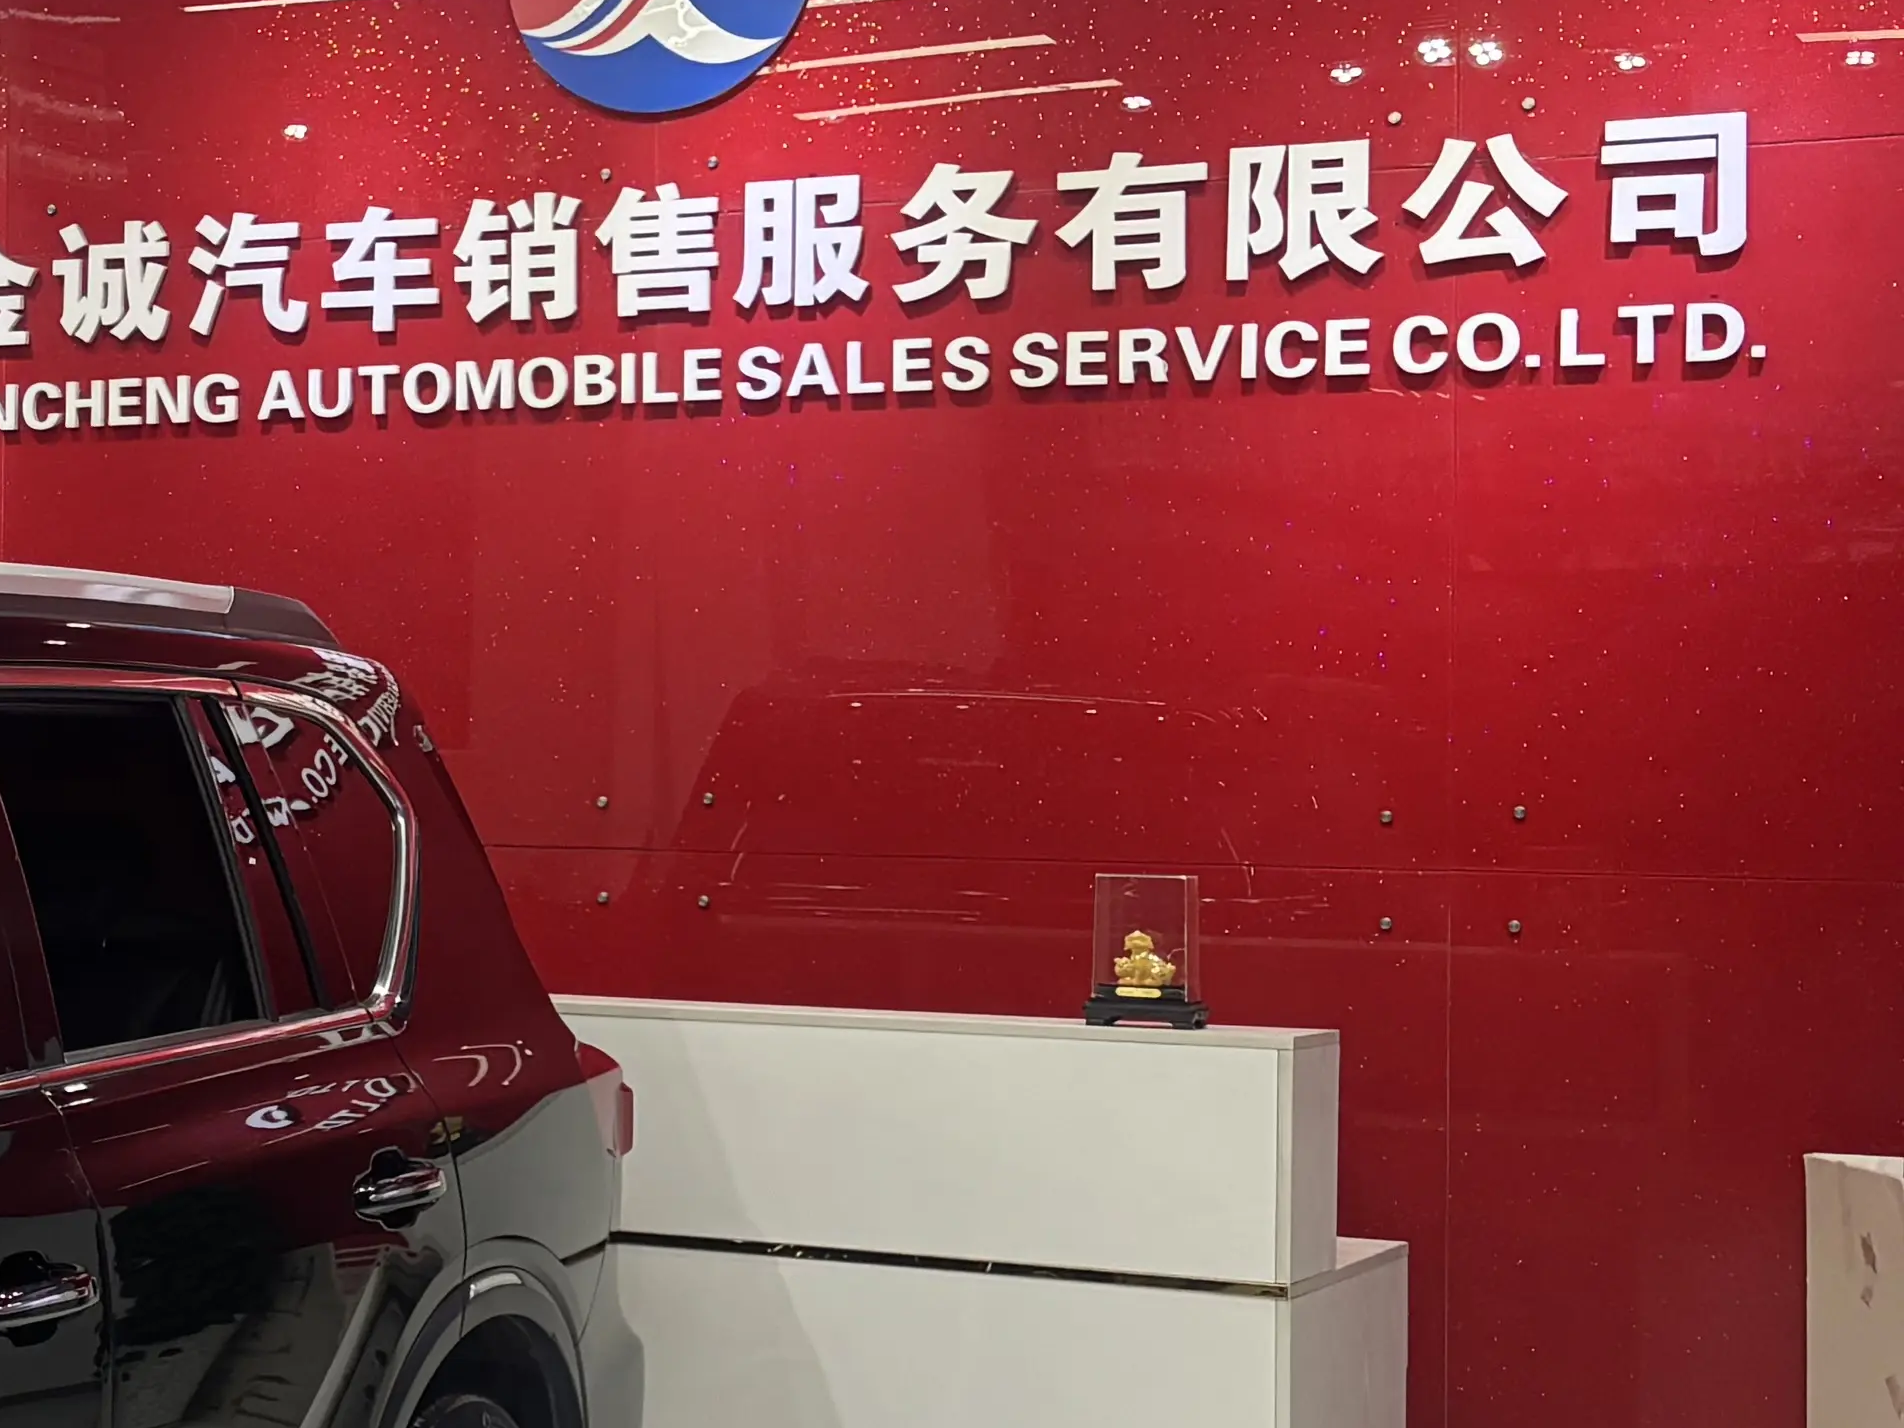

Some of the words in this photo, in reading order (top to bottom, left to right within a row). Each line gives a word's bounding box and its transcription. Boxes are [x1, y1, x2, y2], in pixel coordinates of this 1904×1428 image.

[257, 347, 723, 421] AUTOMOBILE
[735, 334, 992, 402] SALES
[1009, 317, 1372, 389] SERVICE
